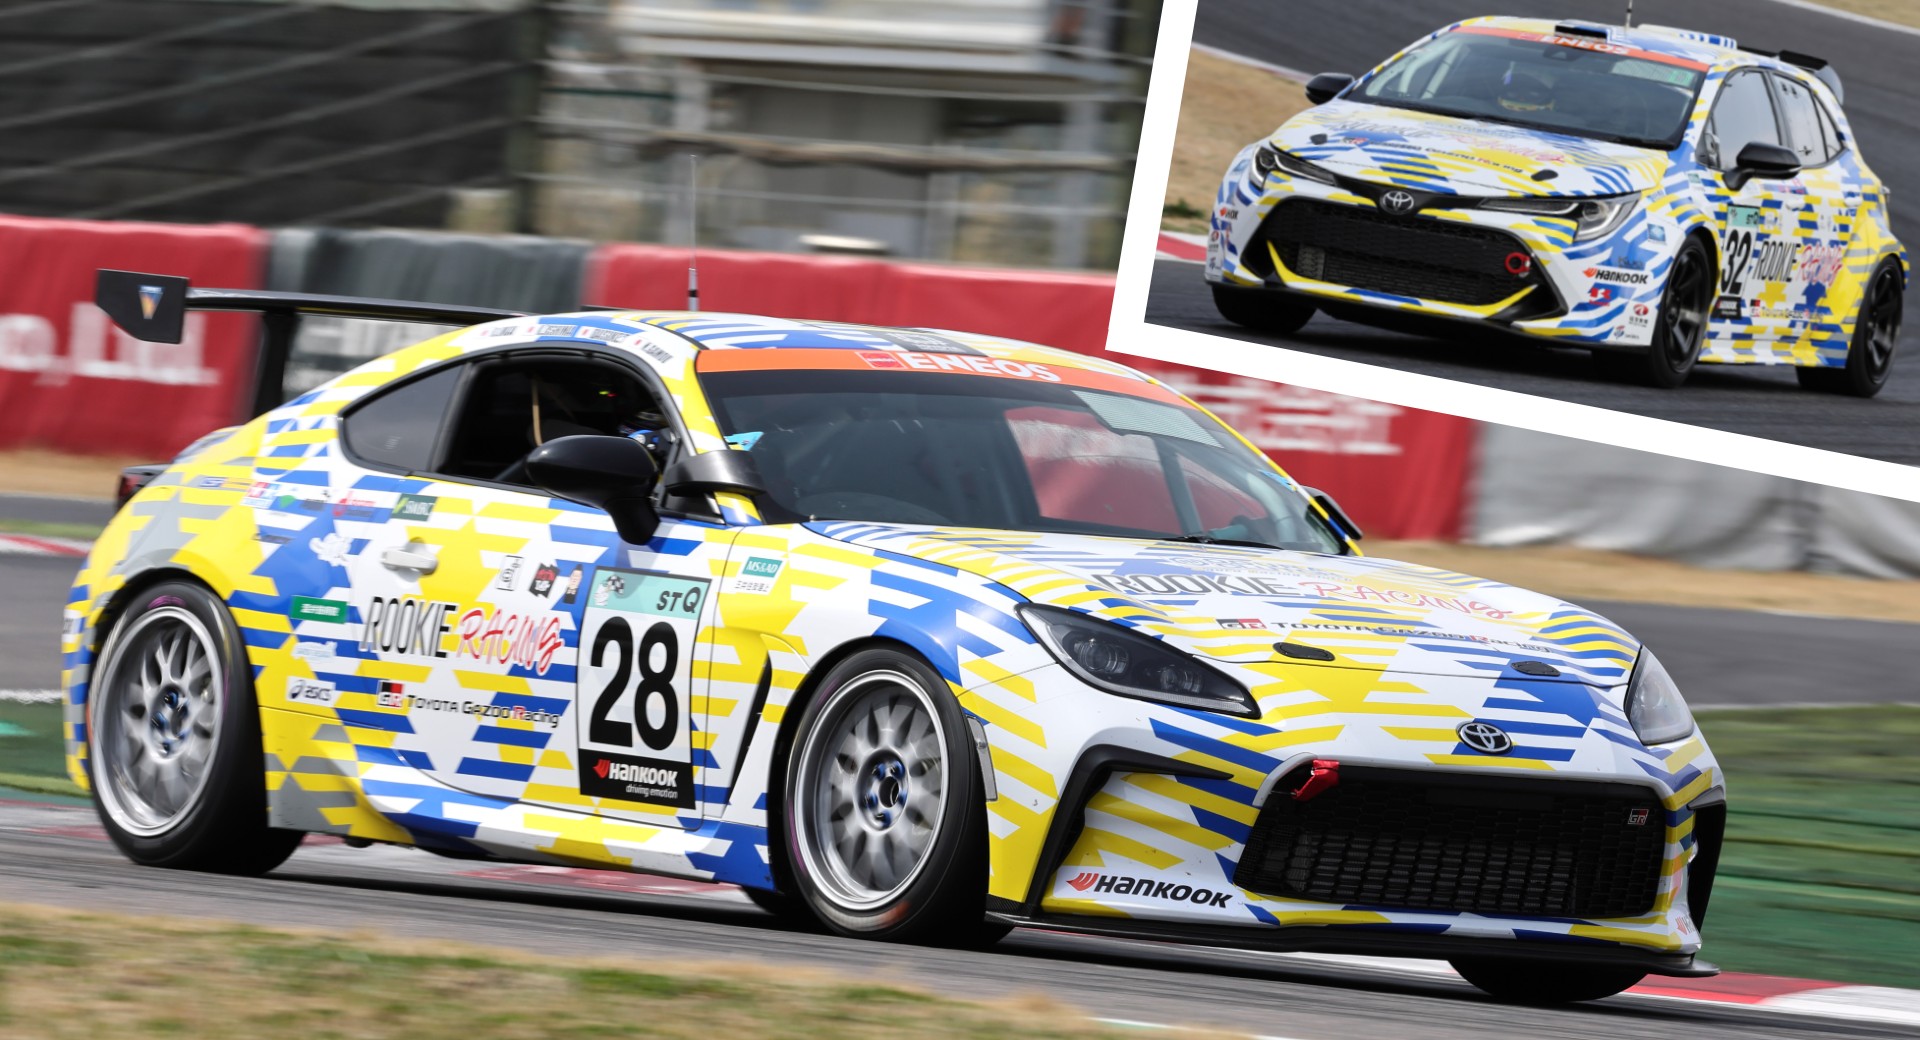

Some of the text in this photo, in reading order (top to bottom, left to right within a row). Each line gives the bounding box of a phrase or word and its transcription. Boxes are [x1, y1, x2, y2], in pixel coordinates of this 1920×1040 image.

[1720, 229, 1752, 295] 32
[1752, 240, 1801, 282] ROOKIE
[896, 352, 1062, 382] ENEOS
[745, 560, 779, 575] MS&AD
[1092, 573, 1514, 620] ROOKIE RACING
[360, 596, 563, 673] ROOKIE RACING
[589, 616, 679, 750] 28
[512, 706, 561, 728] Racing
[625, 784, 678, 799] driving emotion
